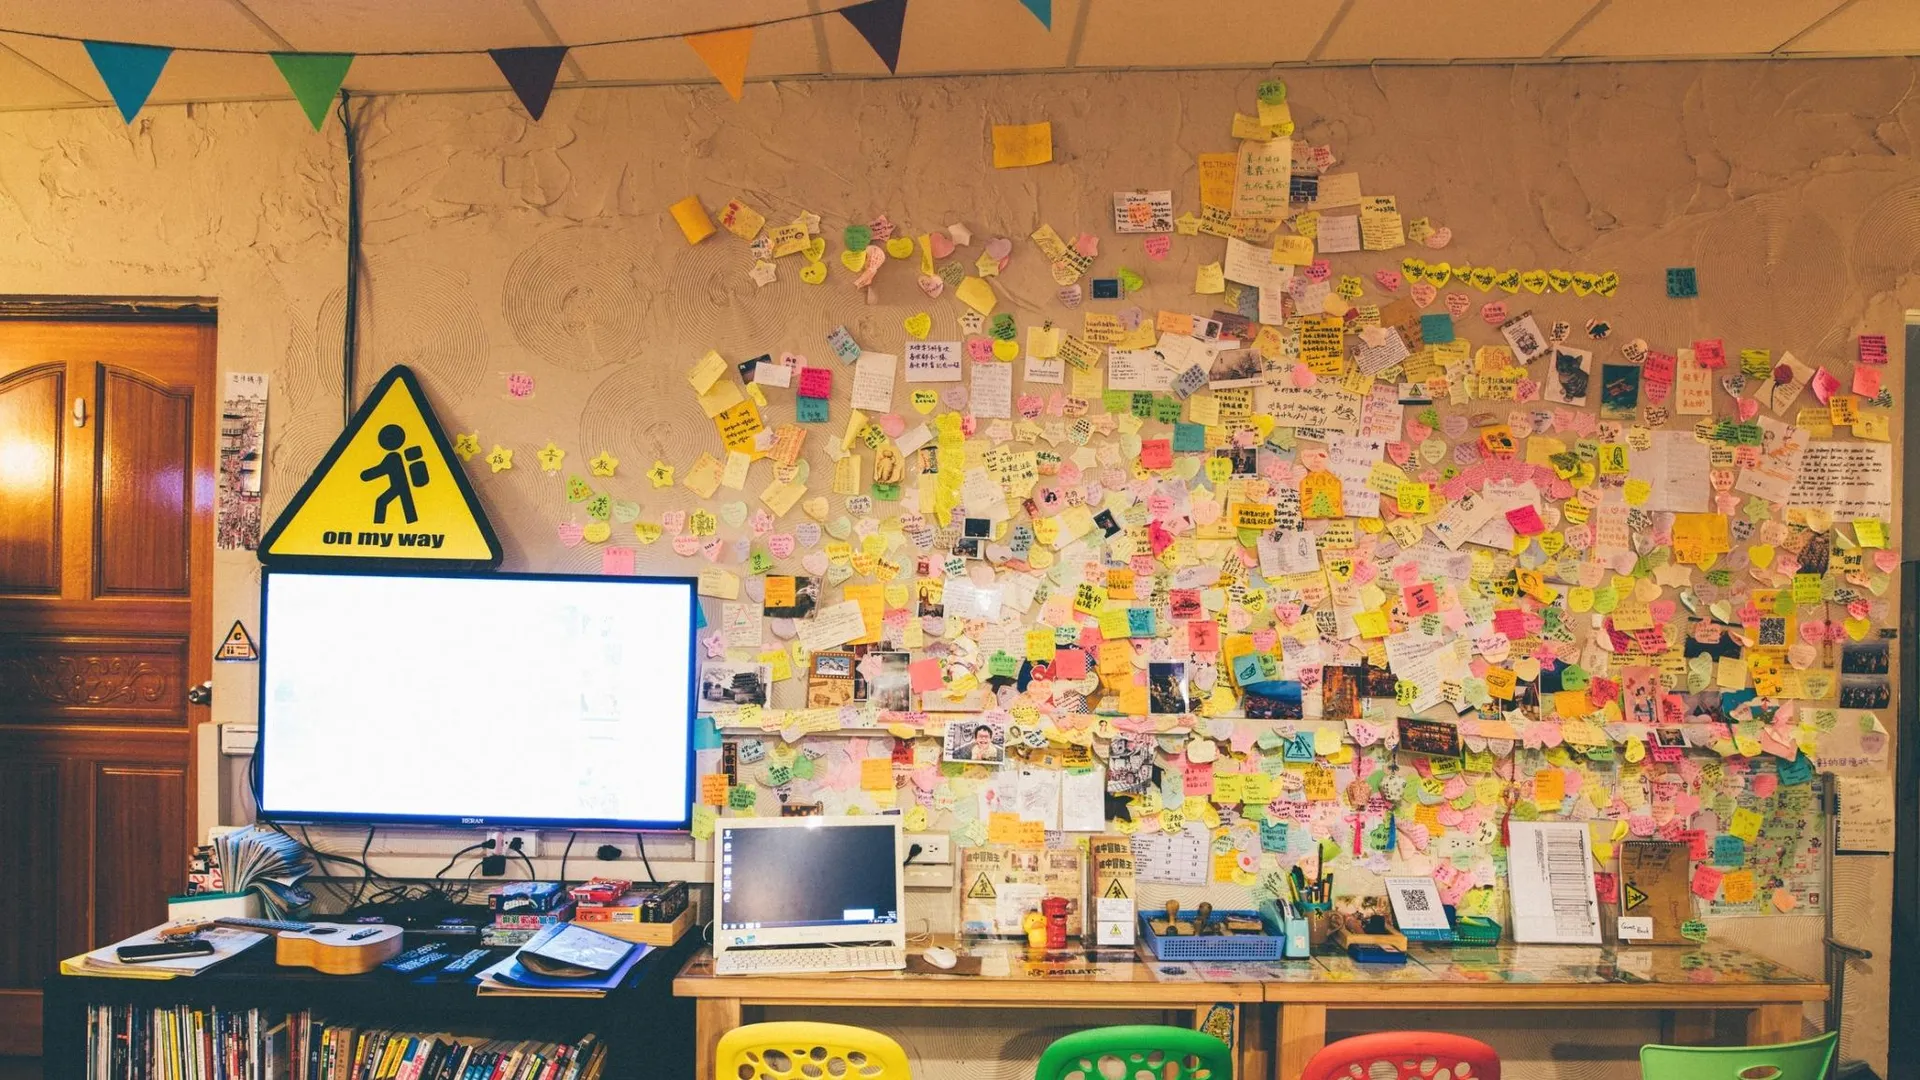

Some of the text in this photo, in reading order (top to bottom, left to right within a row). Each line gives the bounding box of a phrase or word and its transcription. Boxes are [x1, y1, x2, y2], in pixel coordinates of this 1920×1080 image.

[323, 531, 445, 549] on my way
